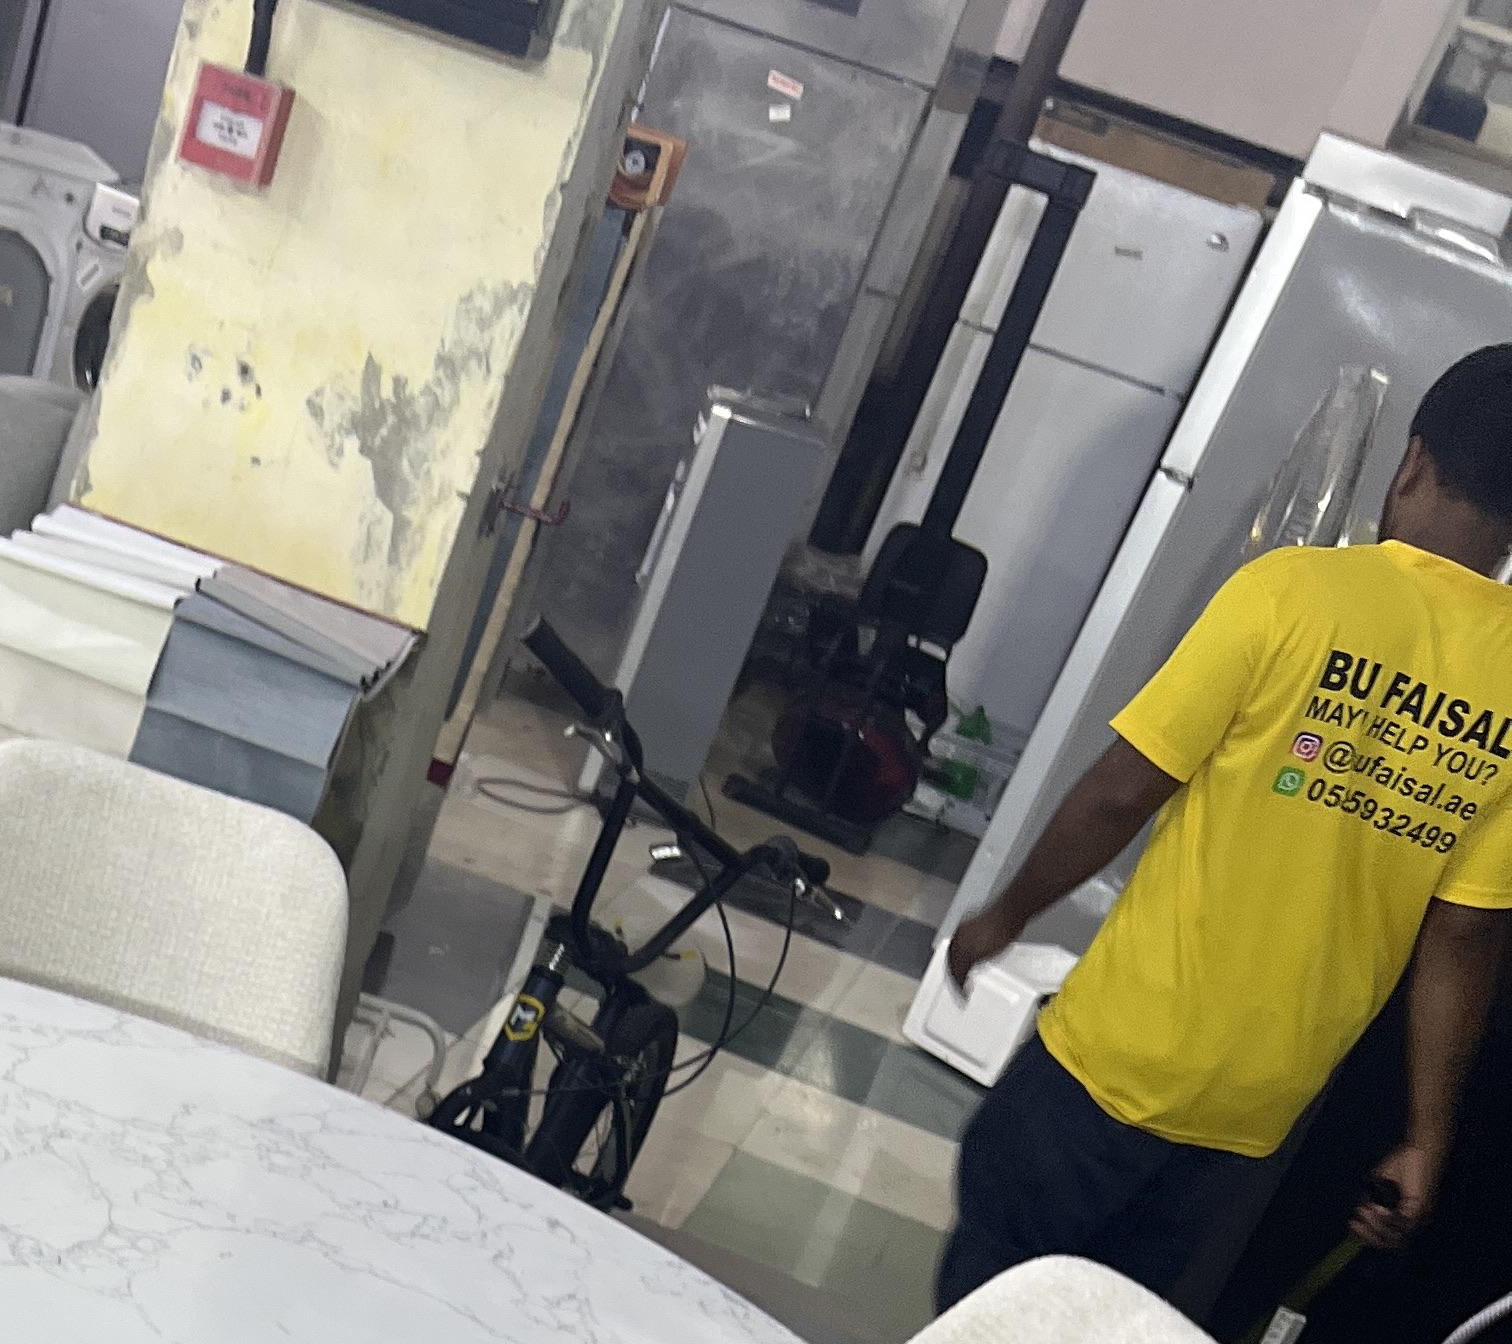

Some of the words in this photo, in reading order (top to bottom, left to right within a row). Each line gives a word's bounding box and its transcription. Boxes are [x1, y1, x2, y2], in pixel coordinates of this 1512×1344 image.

[1304, 695, 1363, 729] MAY
[1366, 715, 1429, 755] HELP
[1433, 743, 1498, 786] YOU?
[1319, 650, 1383, 700] BU
[1380, 671, 1512, 759] FAISAL
